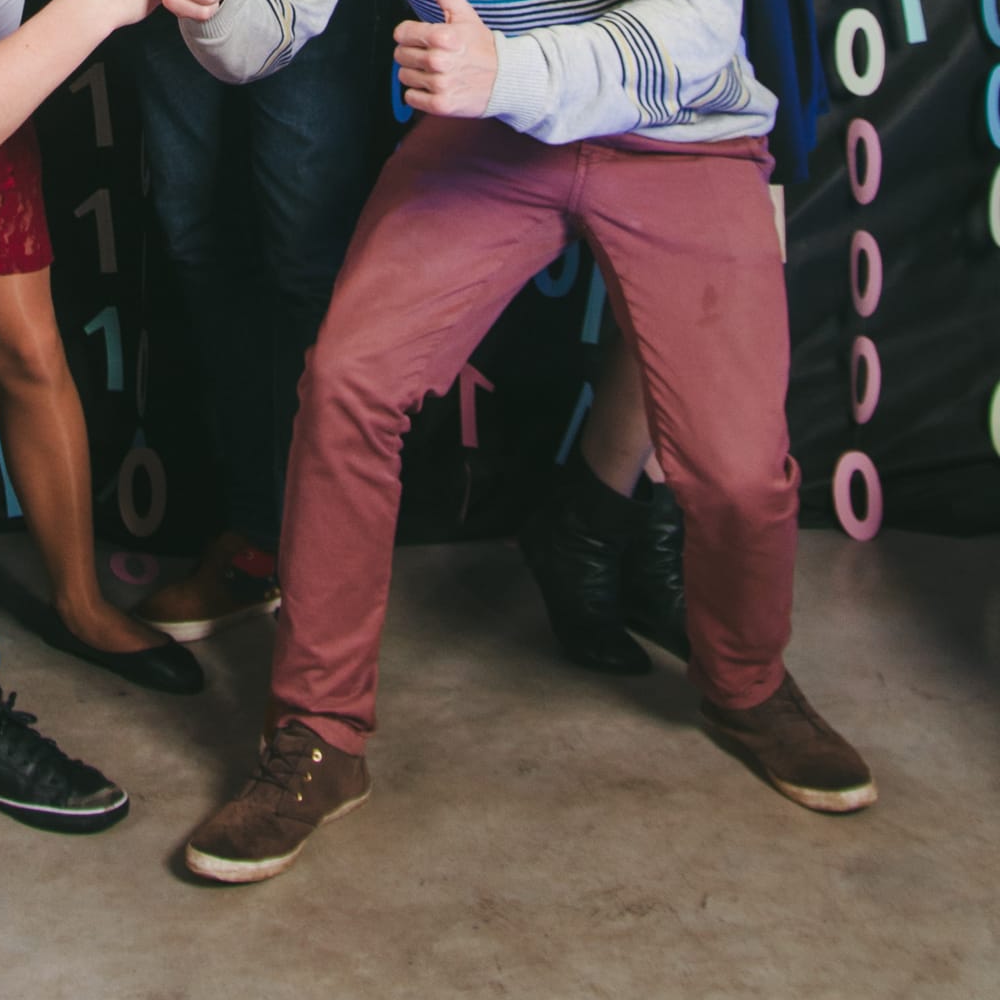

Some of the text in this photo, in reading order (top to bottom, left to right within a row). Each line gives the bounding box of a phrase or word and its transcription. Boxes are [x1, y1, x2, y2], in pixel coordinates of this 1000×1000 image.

[835, 8, 885, 96] 0
[70, 62, 113, 147] 1
[848, 119, 881, 204] 0
[75, 189, 117, 273] 1
[853, 231, 882, 316] 0
[84, 306, 123, 391] 1
[855, 336, 881, 423] 0
[118, 446, 167, 537] 0
[833, 451, 882, 541] 0
